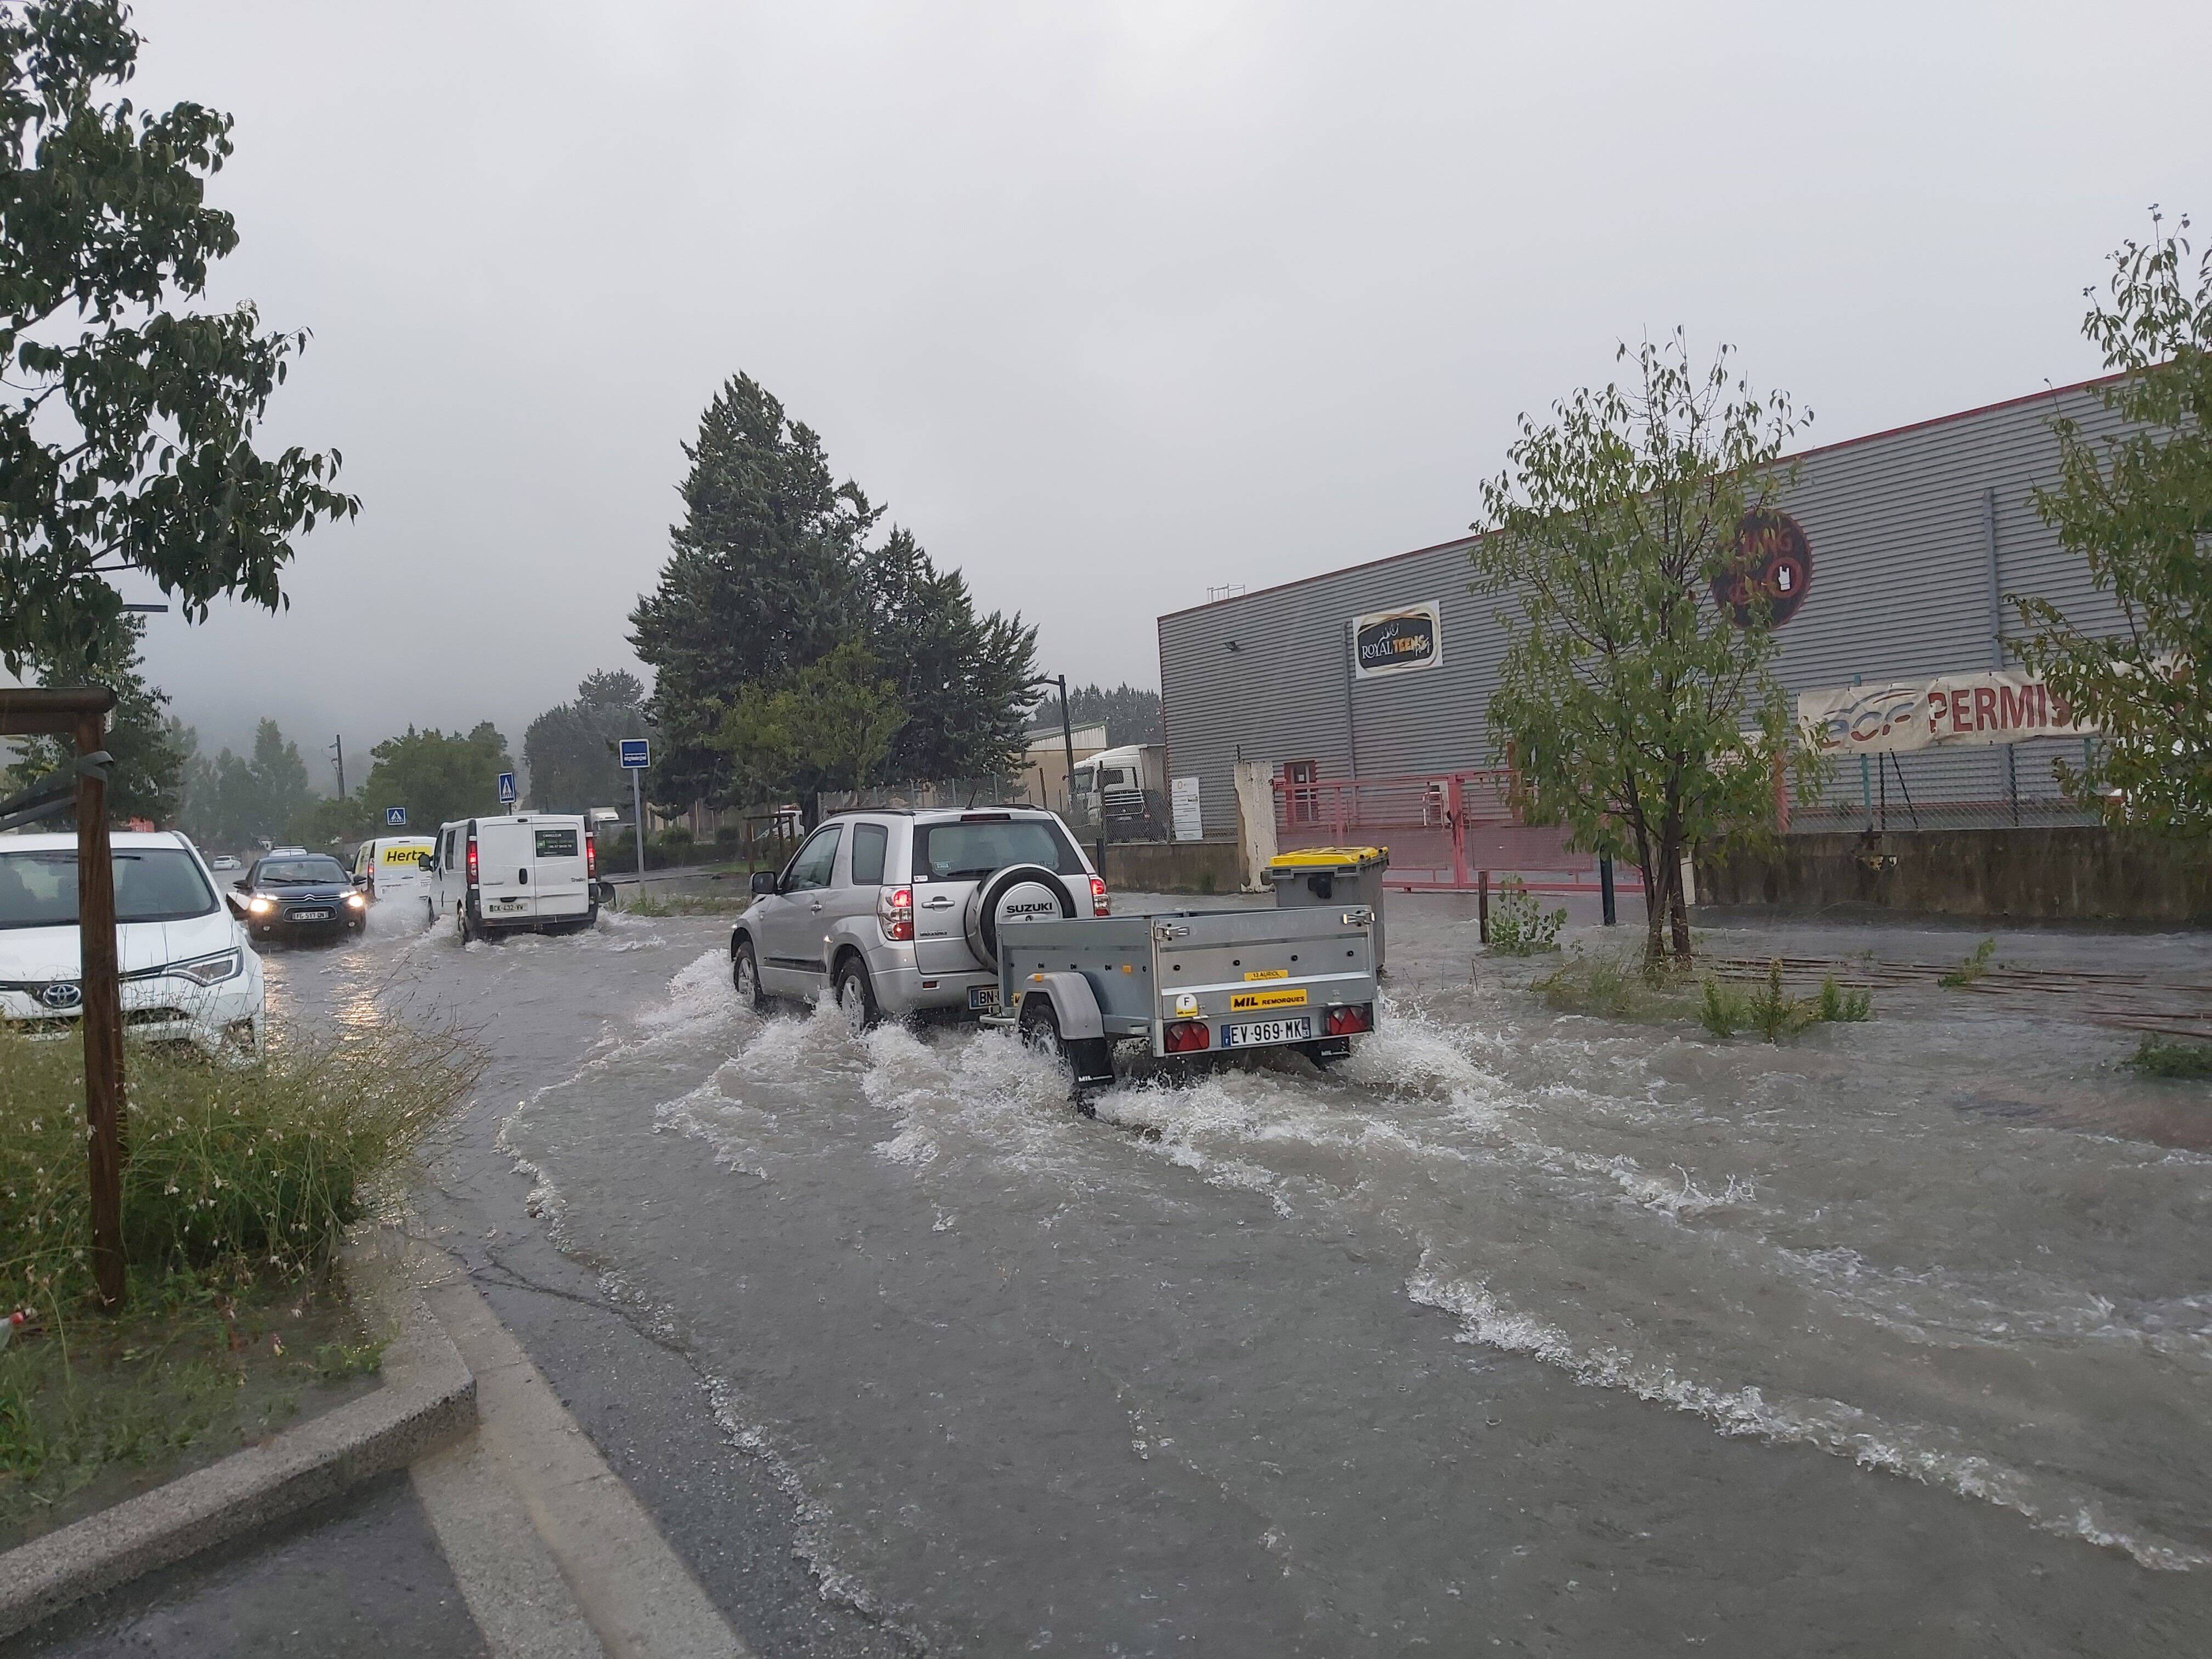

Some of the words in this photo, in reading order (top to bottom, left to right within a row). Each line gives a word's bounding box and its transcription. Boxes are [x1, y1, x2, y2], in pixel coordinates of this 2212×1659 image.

[1362, 641, 1393, 659] ROYAL
[1392, 634, 1425, 654] TEENS
[1006, 902, 1053, 913] SUZUKI
[1184, 997, 1190, 1007] F
[1234, 997, 1259, 1008] MIL
[1262, 996, 1305, 1006] REMORQUES
[1231, 1020, 1302, 1045] EV-969-MK
